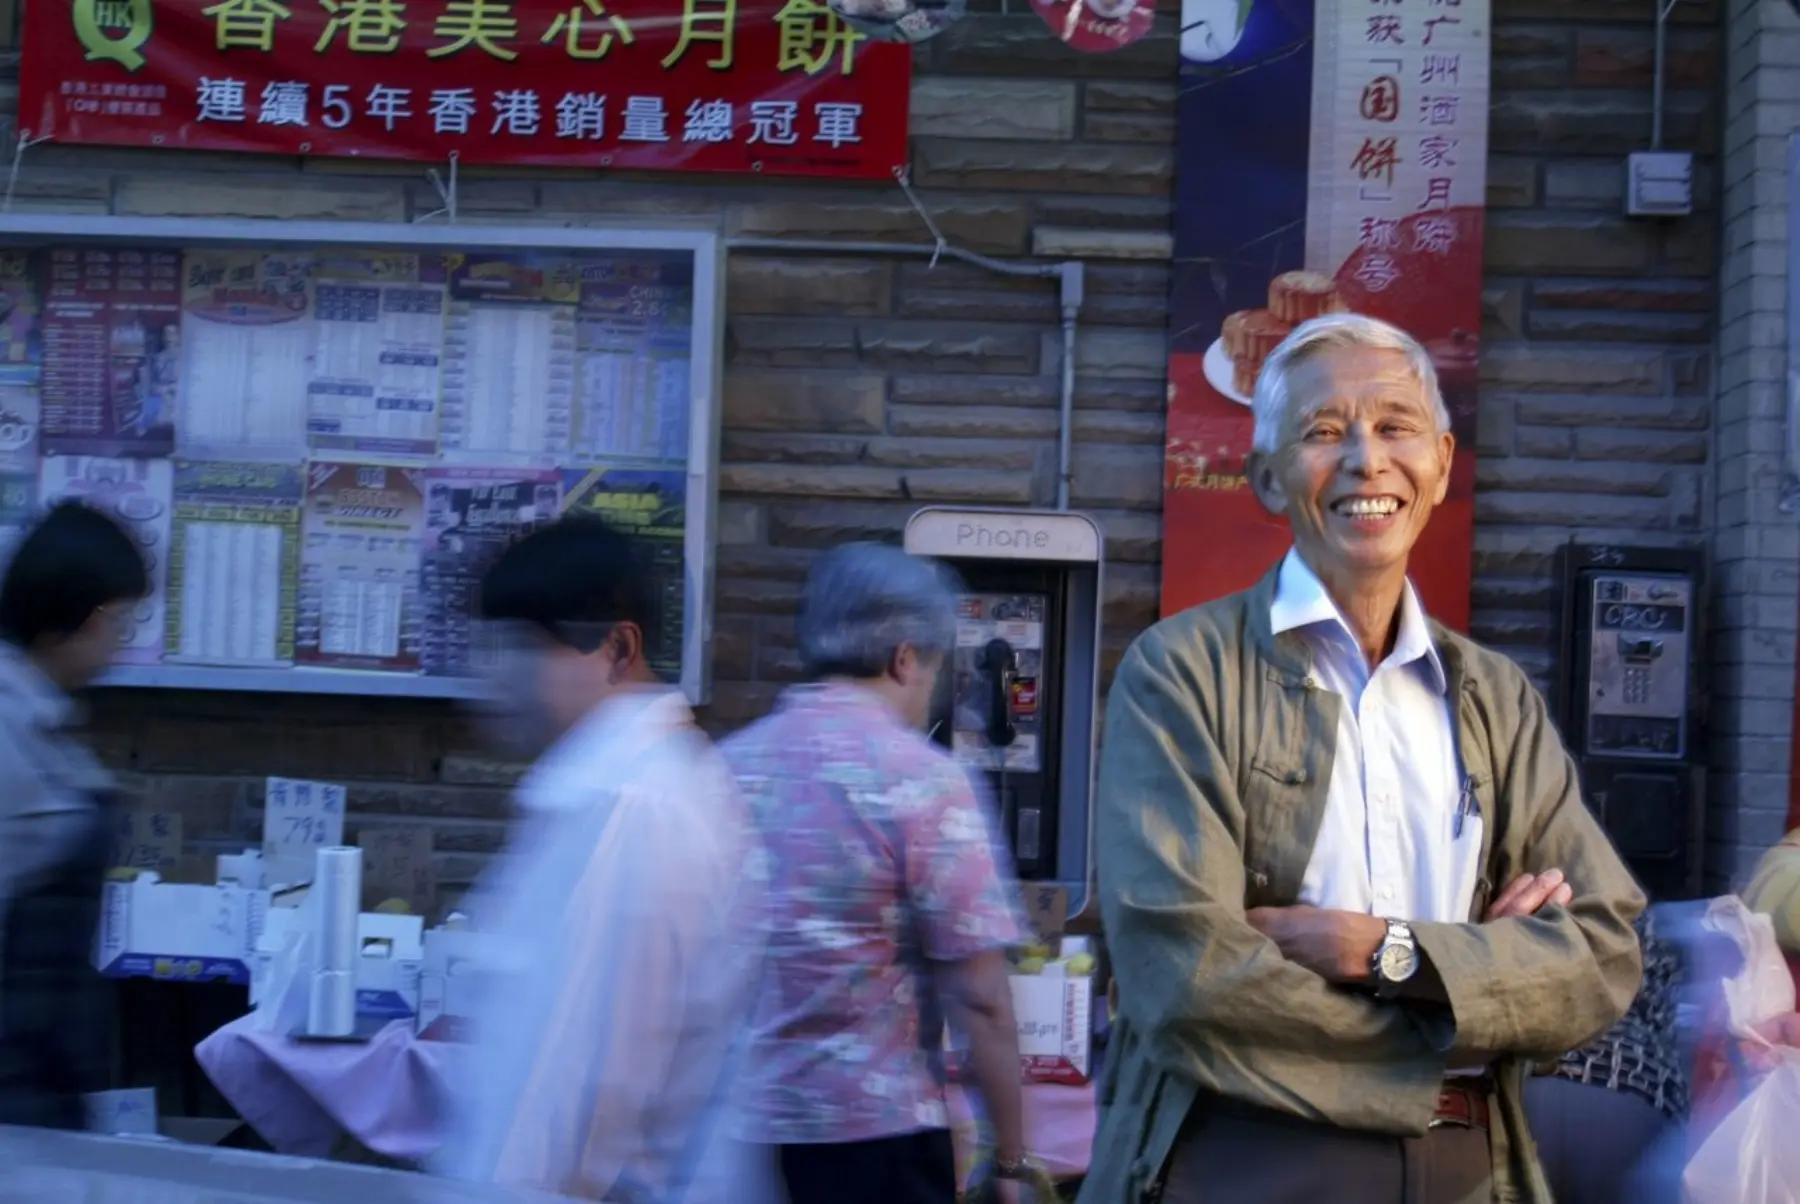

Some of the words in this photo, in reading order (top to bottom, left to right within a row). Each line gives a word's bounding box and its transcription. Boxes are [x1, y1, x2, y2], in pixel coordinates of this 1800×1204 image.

[202, 0, 866, 75] 香港美心月餅
[195, 76, 864, 148] 連續5年香港銷量總冠軍
[1350, 0, 1406, 292] 获「国饼」称号
[1411, 0, 1463, 254] 广州酒家月饼
[956, 523, 1050, 549] Phone
